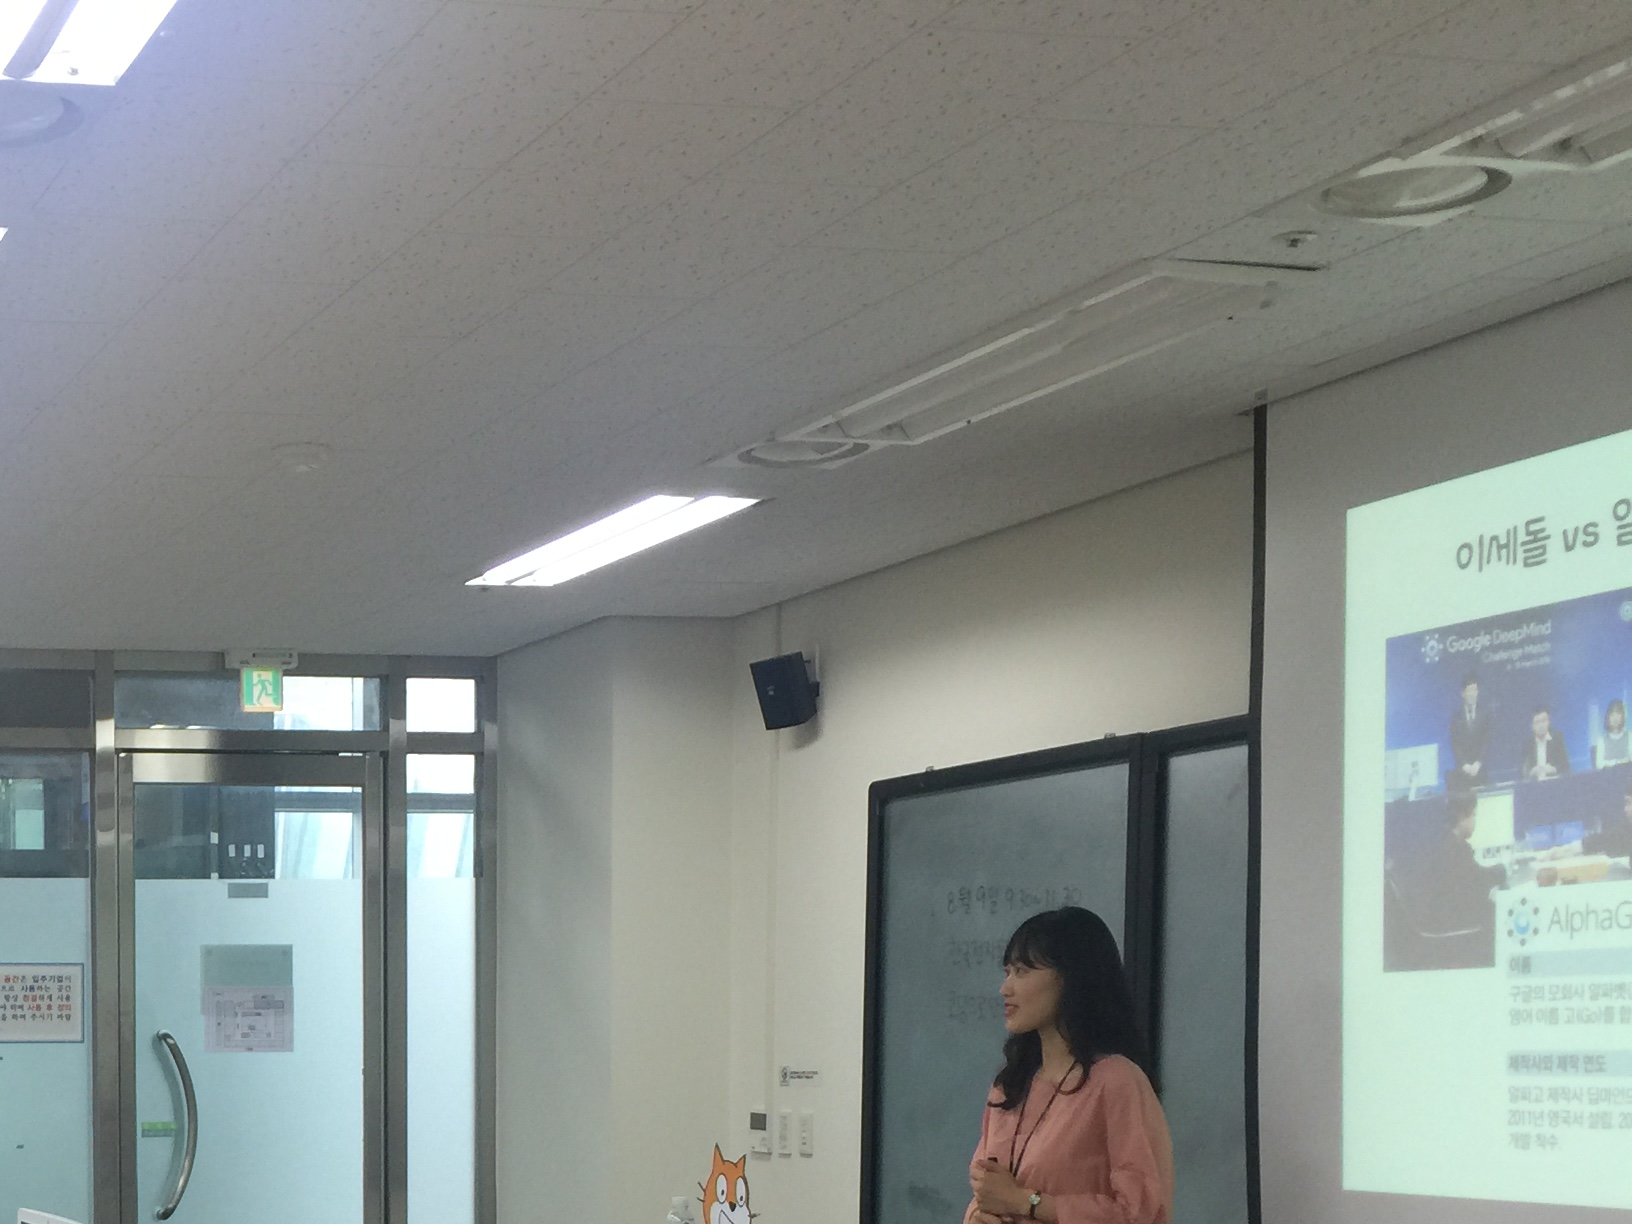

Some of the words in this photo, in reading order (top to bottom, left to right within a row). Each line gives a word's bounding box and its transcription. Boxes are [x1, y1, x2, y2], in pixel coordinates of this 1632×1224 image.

[1456, 515, 1551, 573] 이세돌
[1562, 521, 1600, 553] vs
[1447, 630, 1491, 653] Google
[1492, 619, 1552, 645] DeepMind
[1548, 900, 1632, 940] AlphaG
